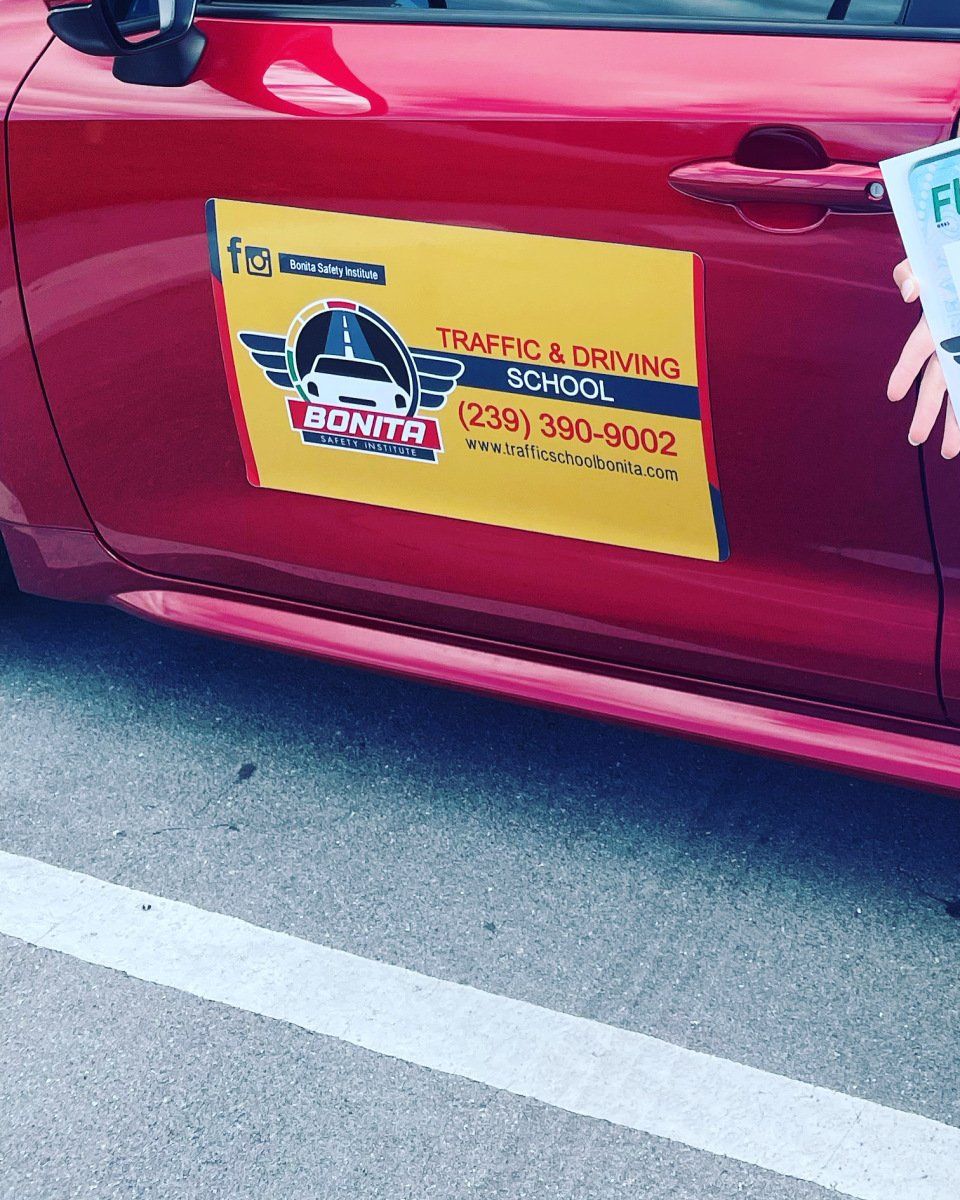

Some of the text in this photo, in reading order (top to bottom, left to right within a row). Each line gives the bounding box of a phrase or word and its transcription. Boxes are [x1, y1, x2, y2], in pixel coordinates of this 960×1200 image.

[289, 259, 379, 281] Bonita Safety Institute
[436, 326, 681, 379] TRAFFIC & DRIVING
[507, 367, 615, 402] SCHOOL
[303, 405, 427, 445] BONITA
[458, 400, 678, 457] (239) 390-9002
[321, 435, 417, 456] SAFETY INSTITUTE
[465, 438, 679, 482] www.trafficschoolbonita.com
